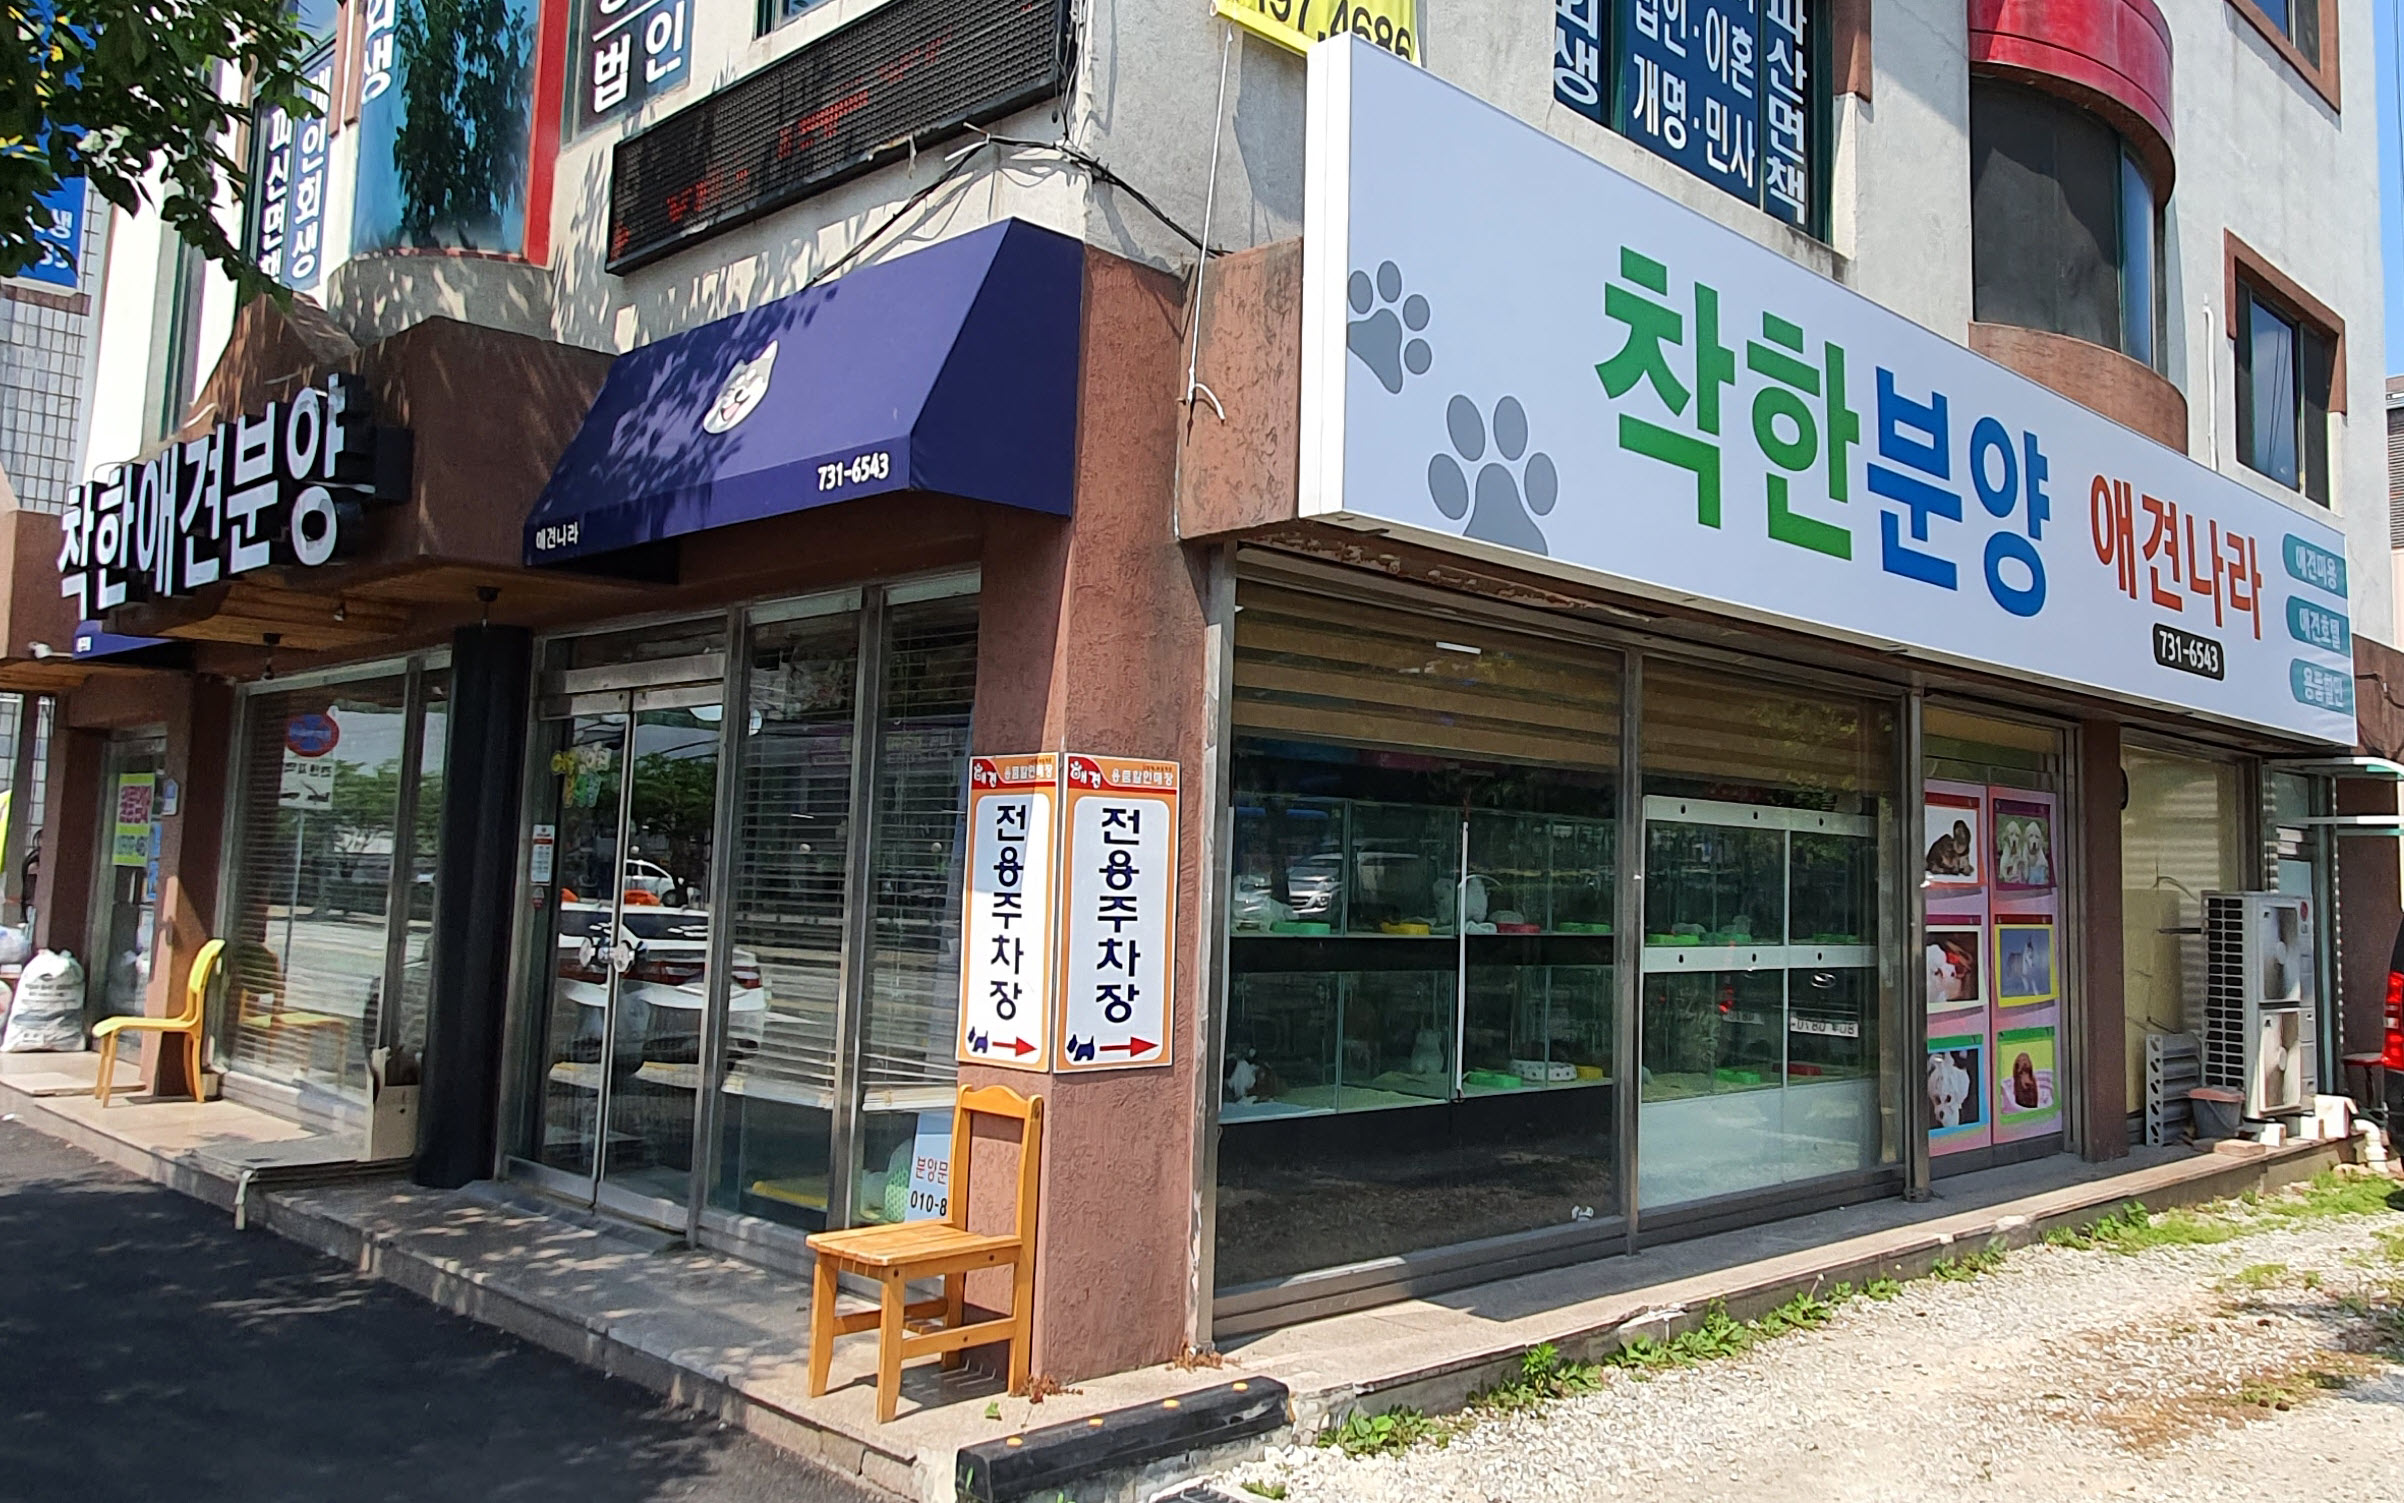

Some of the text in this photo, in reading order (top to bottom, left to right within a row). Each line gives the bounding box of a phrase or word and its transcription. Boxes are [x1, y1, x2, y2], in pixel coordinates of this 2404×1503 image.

[1766, 0, 1808, 225] 파산면책
[816, 452, 890, 492] 731-6543
[1594, 245, 2050, 618] 착한분양
[535, 521, 580, 551] 애견나라
[2090, 474, 2263, 641] 애견나라
[2158, 630, 2220, 674] 731-6543
[988, 804, 1027, 1021] 전용주차장
[1094, 806, 1142, 1025] 전용주차장
